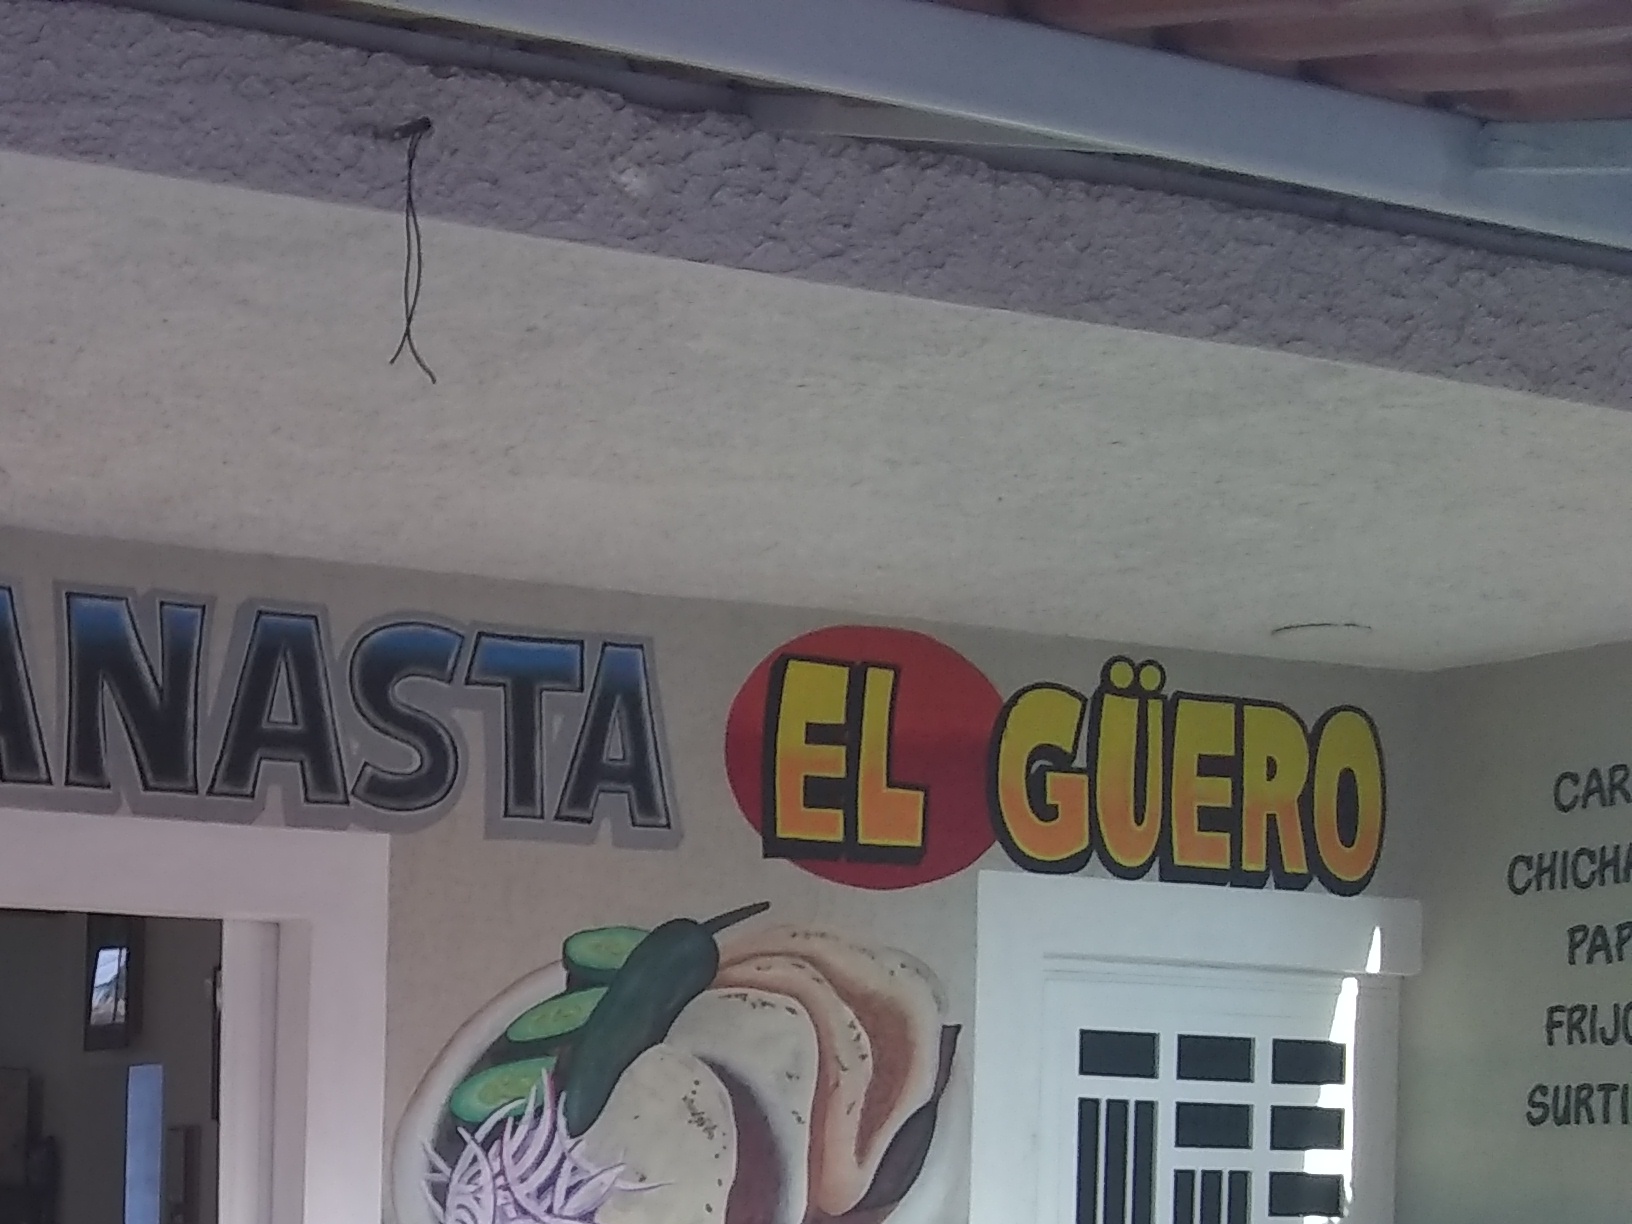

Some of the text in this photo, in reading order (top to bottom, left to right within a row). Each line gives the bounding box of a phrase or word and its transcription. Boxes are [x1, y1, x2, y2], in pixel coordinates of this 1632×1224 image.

[764, 655, 928, 865] EL
[989, 655, 1387, 897] GÜERO
[1553, 763, 1632, 814] CAR
[1526, 1083, 1632, 1127] SURTI
